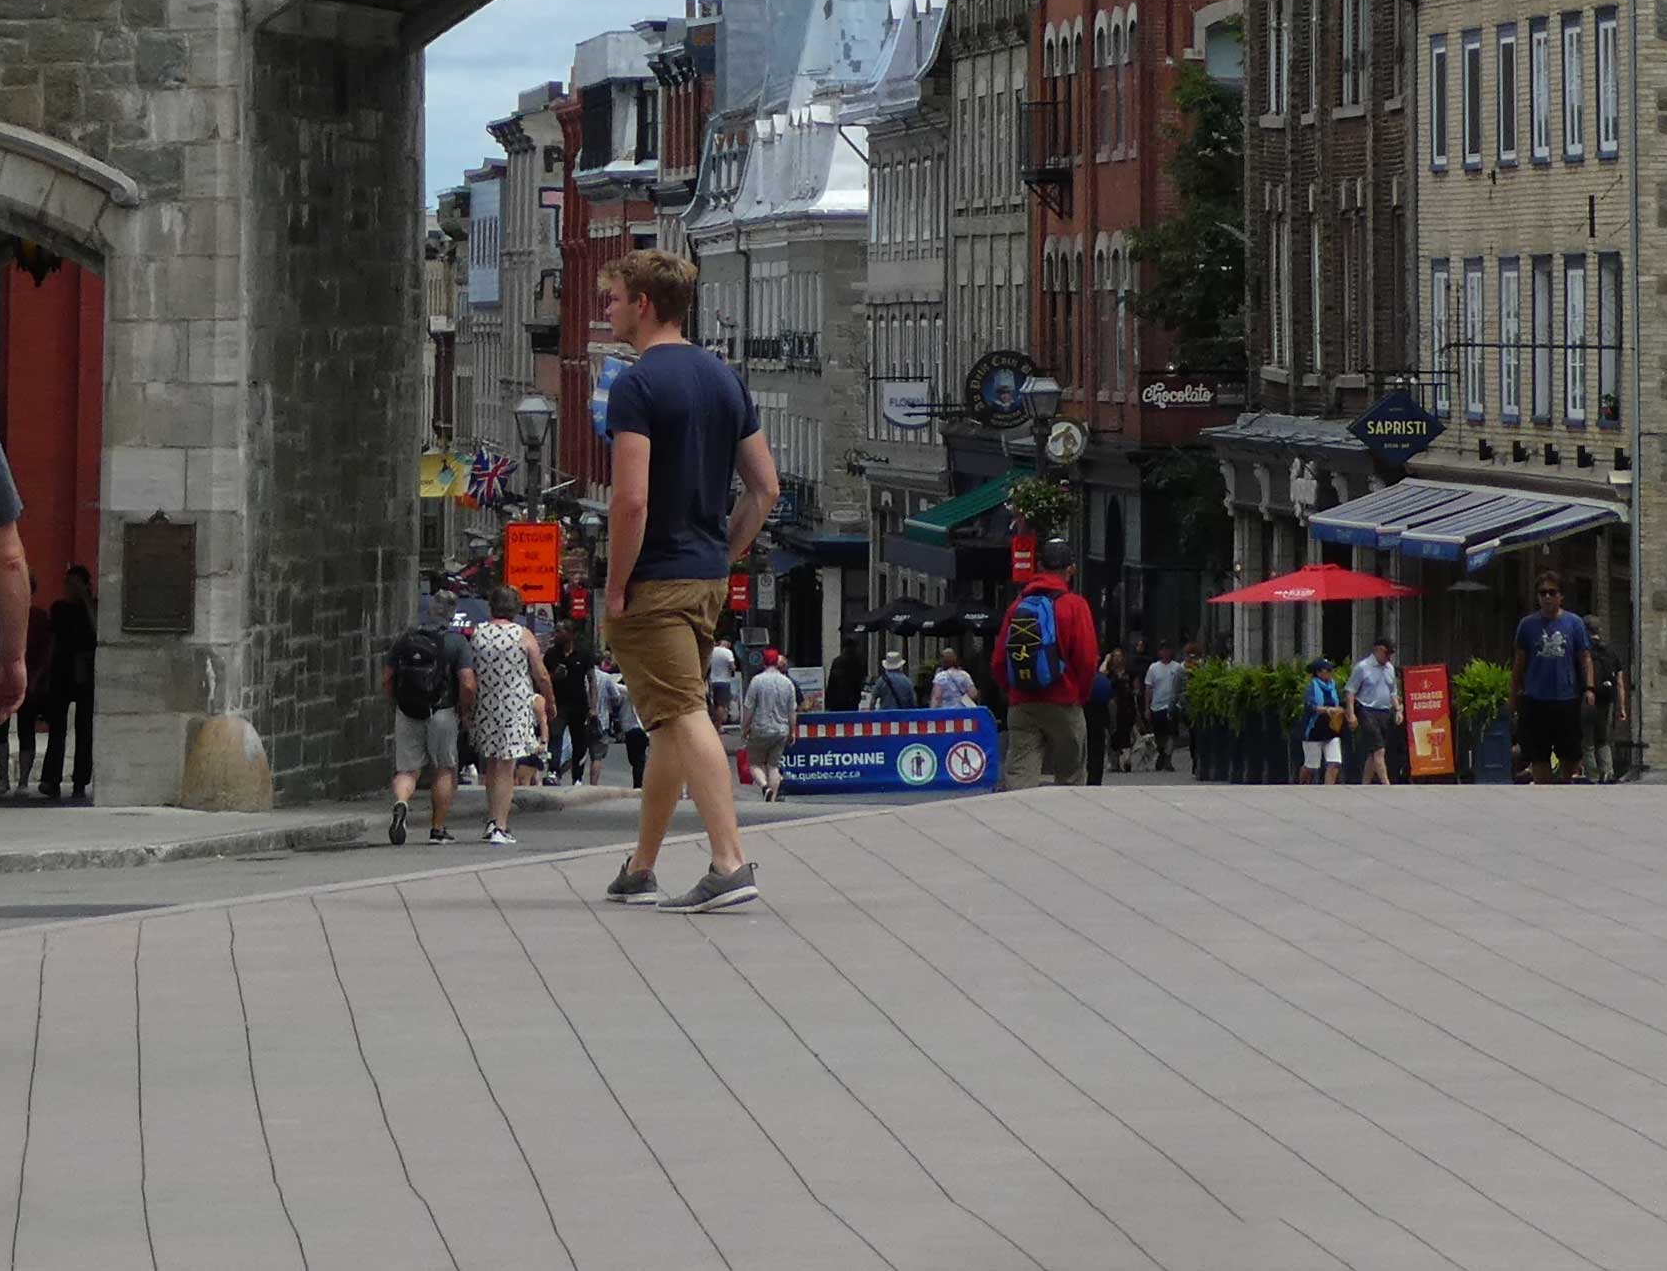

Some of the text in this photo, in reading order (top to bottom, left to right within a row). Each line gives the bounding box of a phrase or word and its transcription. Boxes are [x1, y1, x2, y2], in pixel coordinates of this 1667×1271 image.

[1141, 382, 1214, 409] Chocolato
[1366, 420, 1427, 436] SAPRISTI
[780, 750, 885, 768] RUE PIÉTONNE
